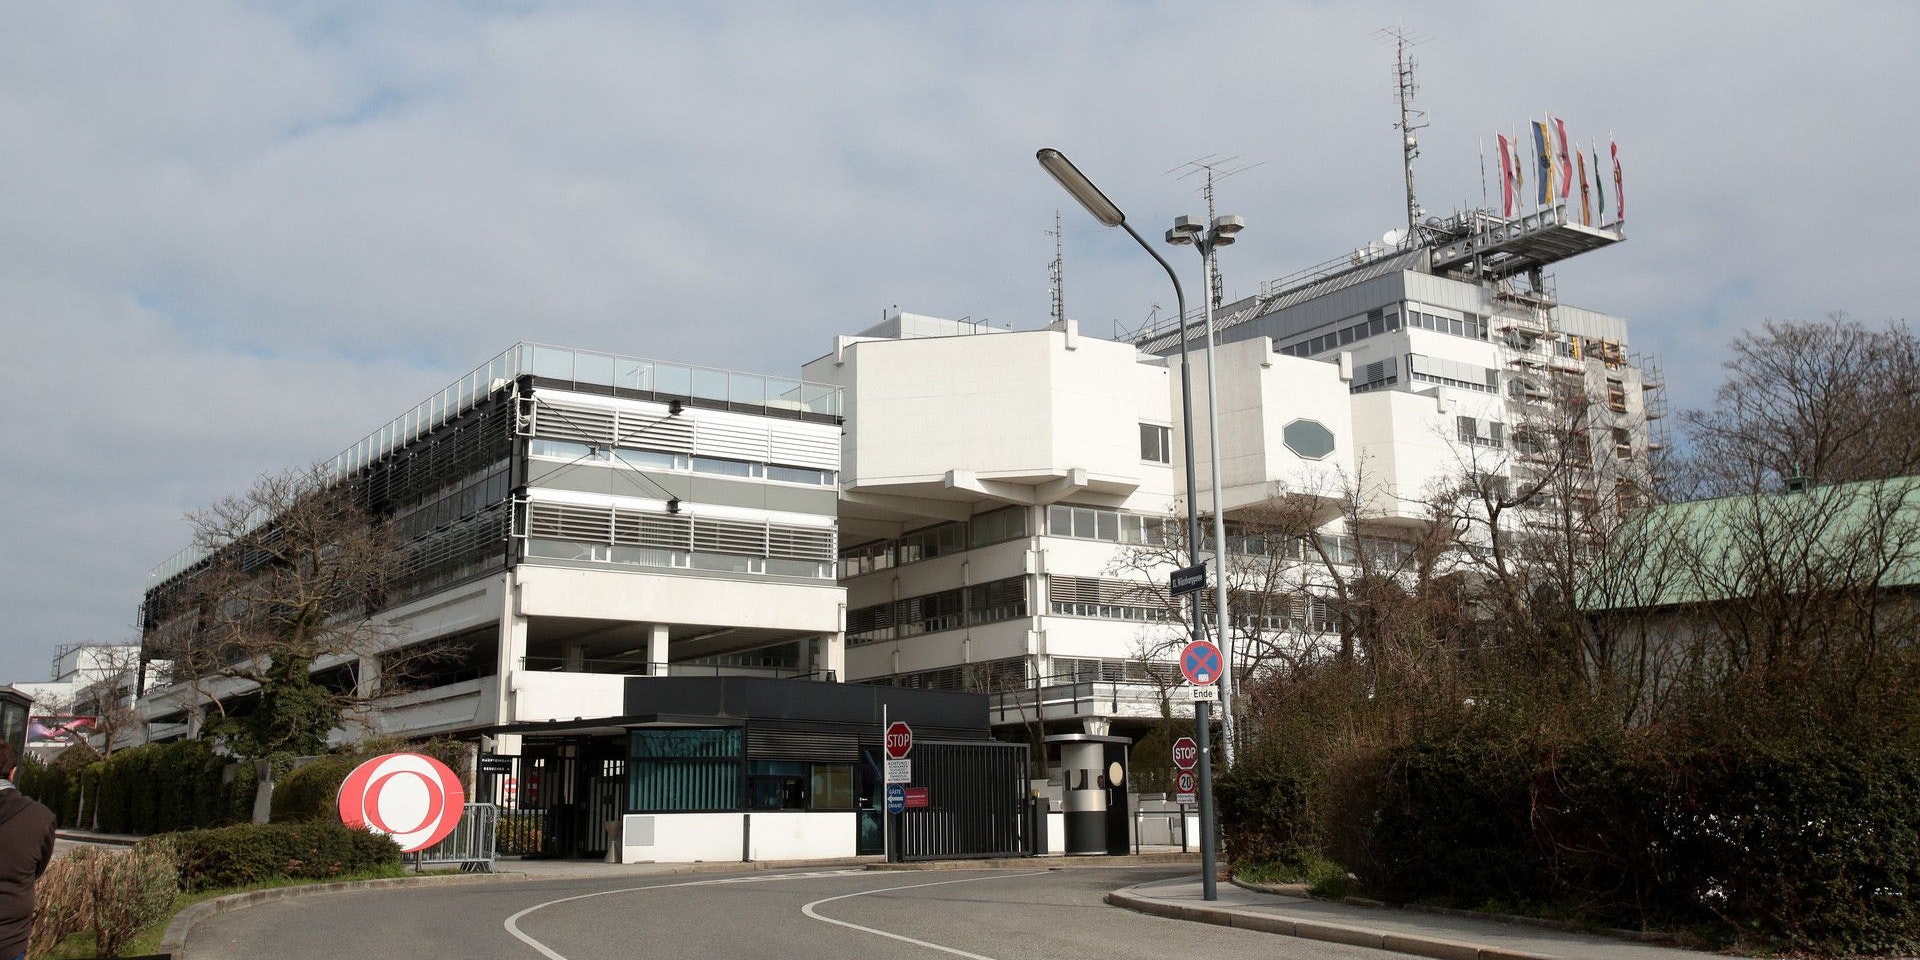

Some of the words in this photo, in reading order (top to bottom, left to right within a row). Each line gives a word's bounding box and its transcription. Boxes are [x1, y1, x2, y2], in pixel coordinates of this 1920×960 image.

[1193, 689, 1213, 698] Ende
[888, 734, 909, 747] STOP
[1175, 747, 1196, 760] STOP
[1181, 776, 1192, 788] 20
